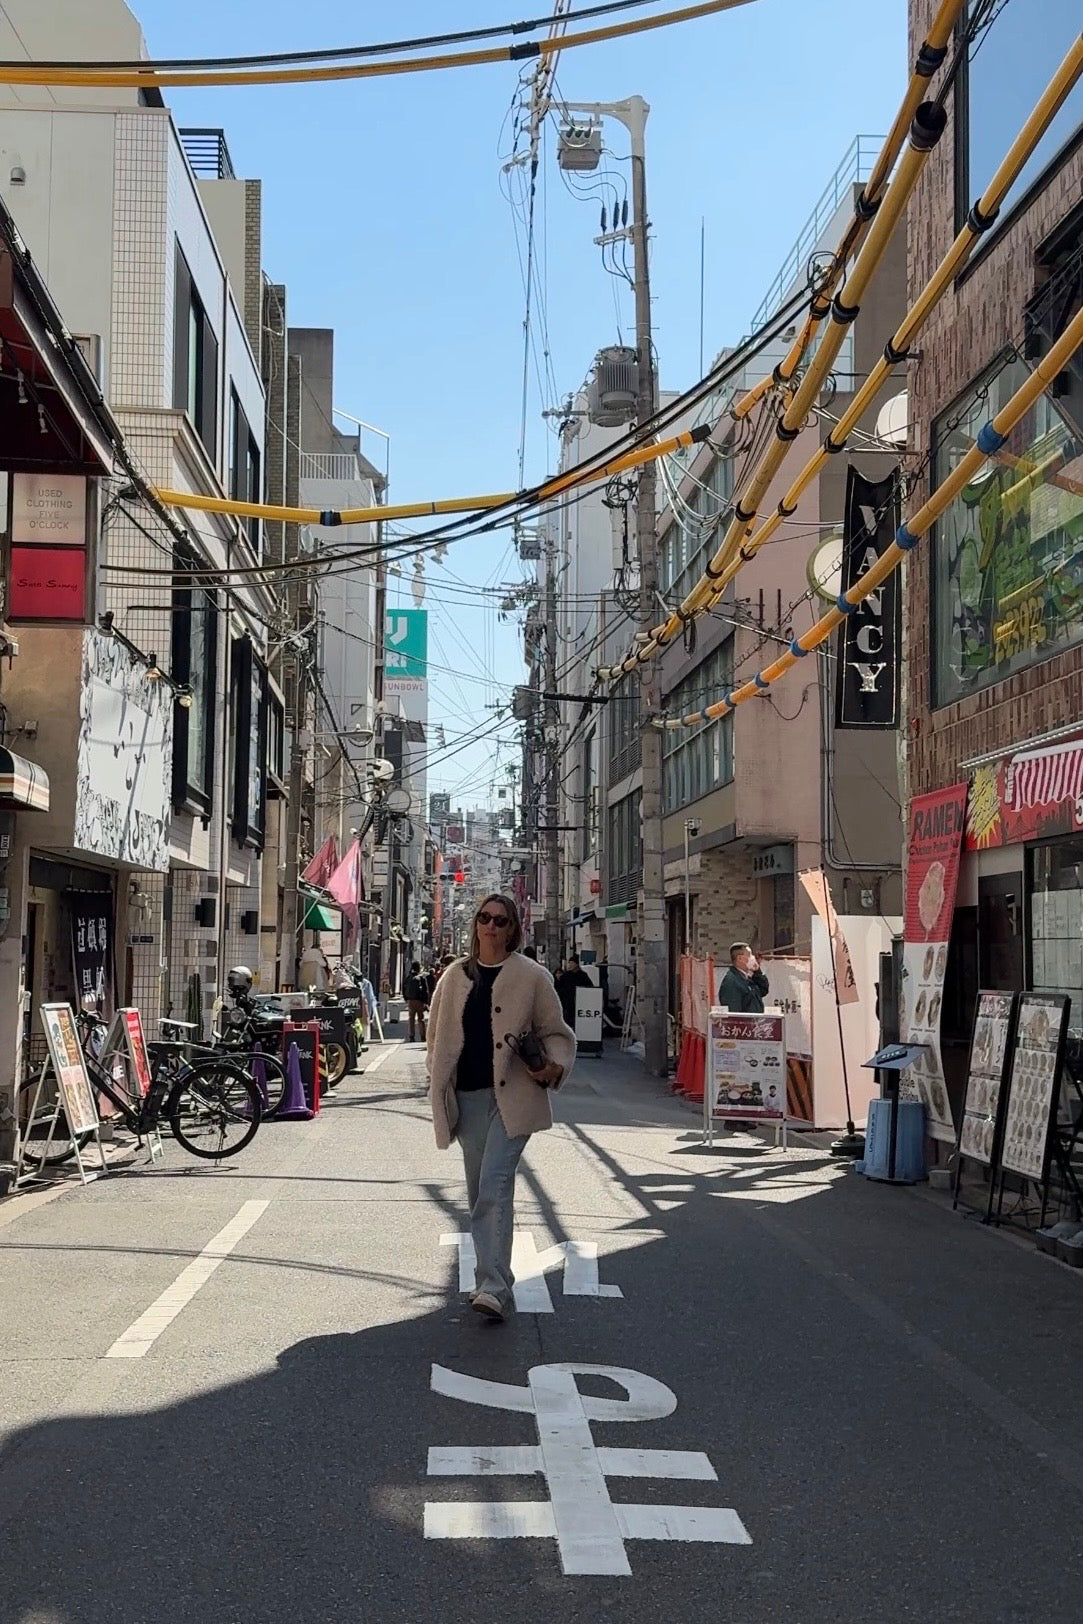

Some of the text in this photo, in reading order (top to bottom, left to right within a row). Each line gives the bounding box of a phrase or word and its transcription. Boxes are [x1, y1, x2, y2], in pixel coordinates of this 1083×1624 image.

[38, 489, 63, 497] USED
[26, 499, 73, 509] CLOTHING
[39, 511, 60, 519] FIVE
[29, 520, 69, 530] O'CLOCK
[911, 802, 963, 841] RAMEN
